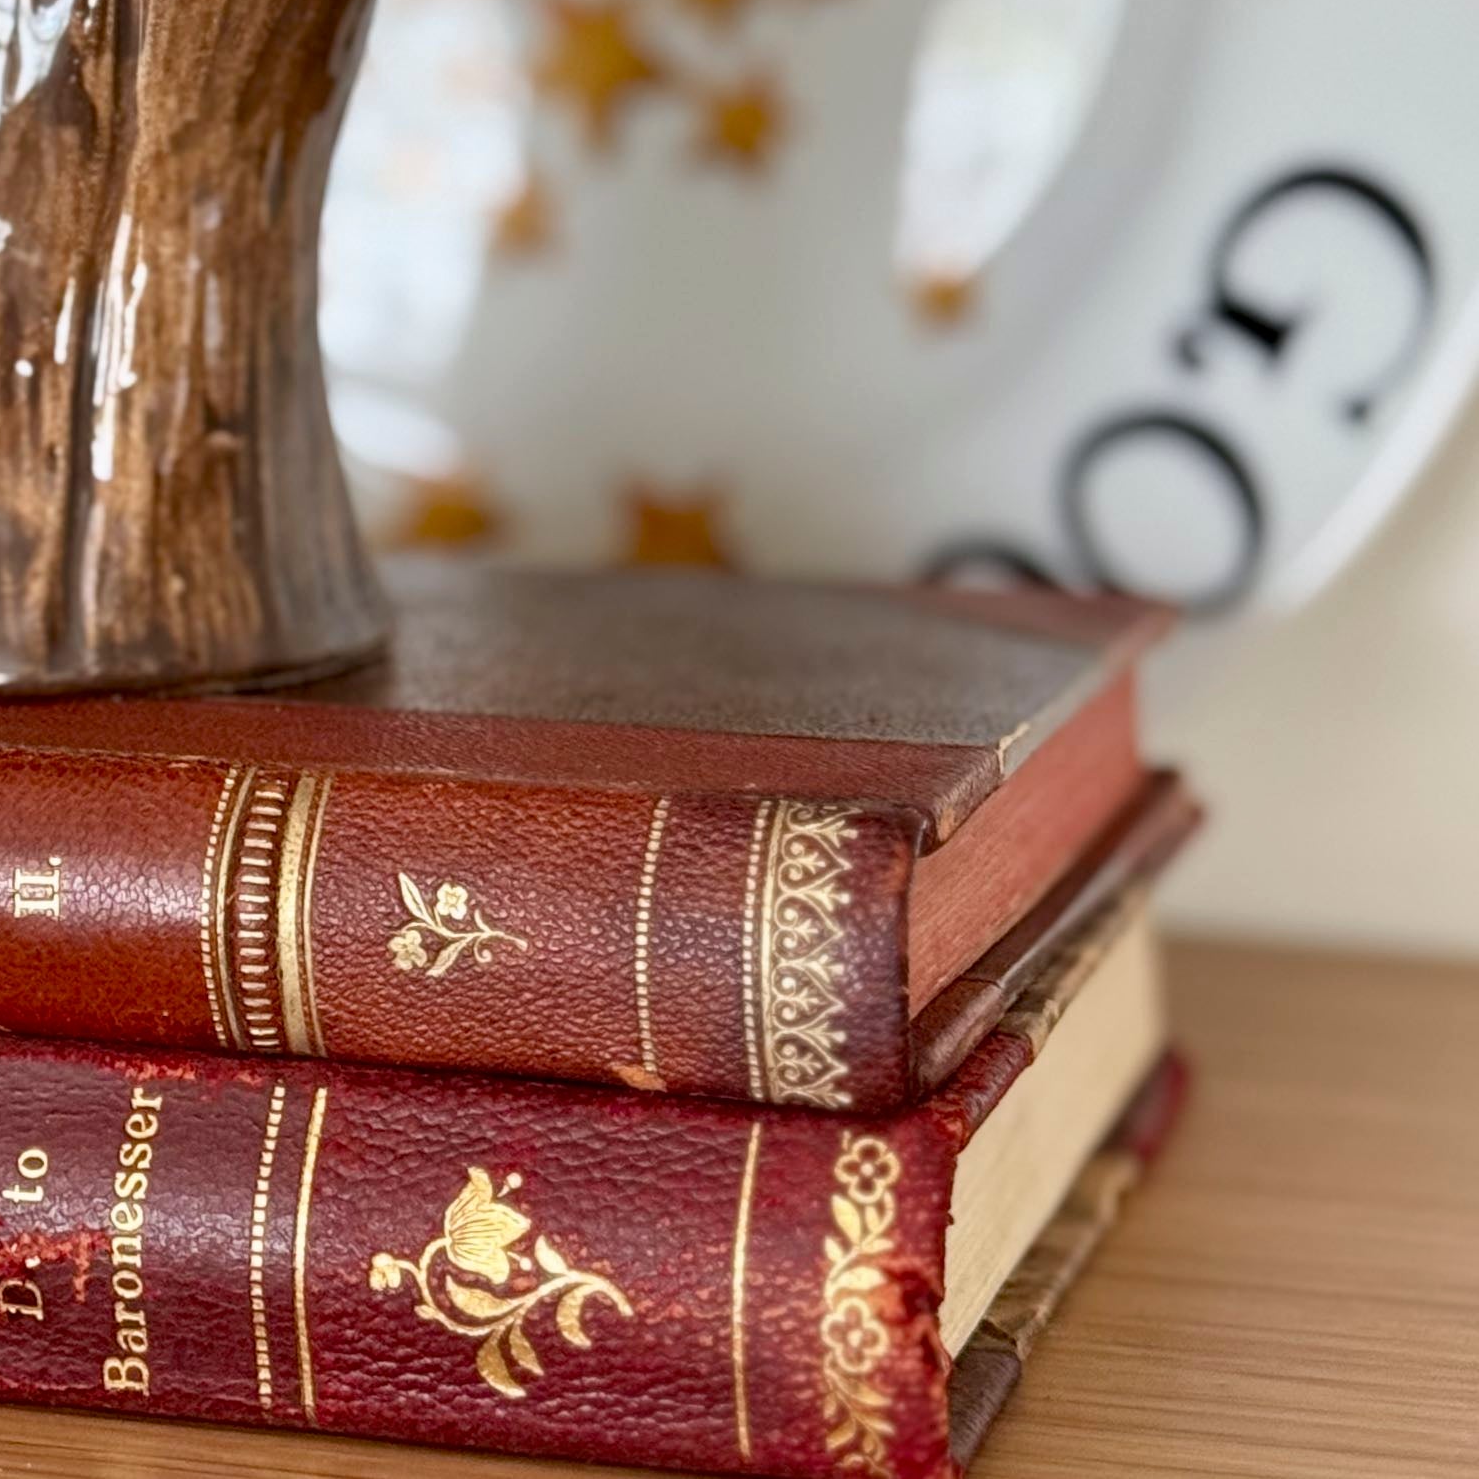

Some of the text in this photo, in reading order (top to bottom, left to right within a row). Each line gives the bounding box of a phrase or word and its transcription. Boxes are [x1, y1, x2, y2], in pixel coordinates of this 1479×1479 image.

[13, 856, 62, 918] II.
[1, 1148, 49, 1204] to
[103, 1087, 163, 1397] Baronesser
